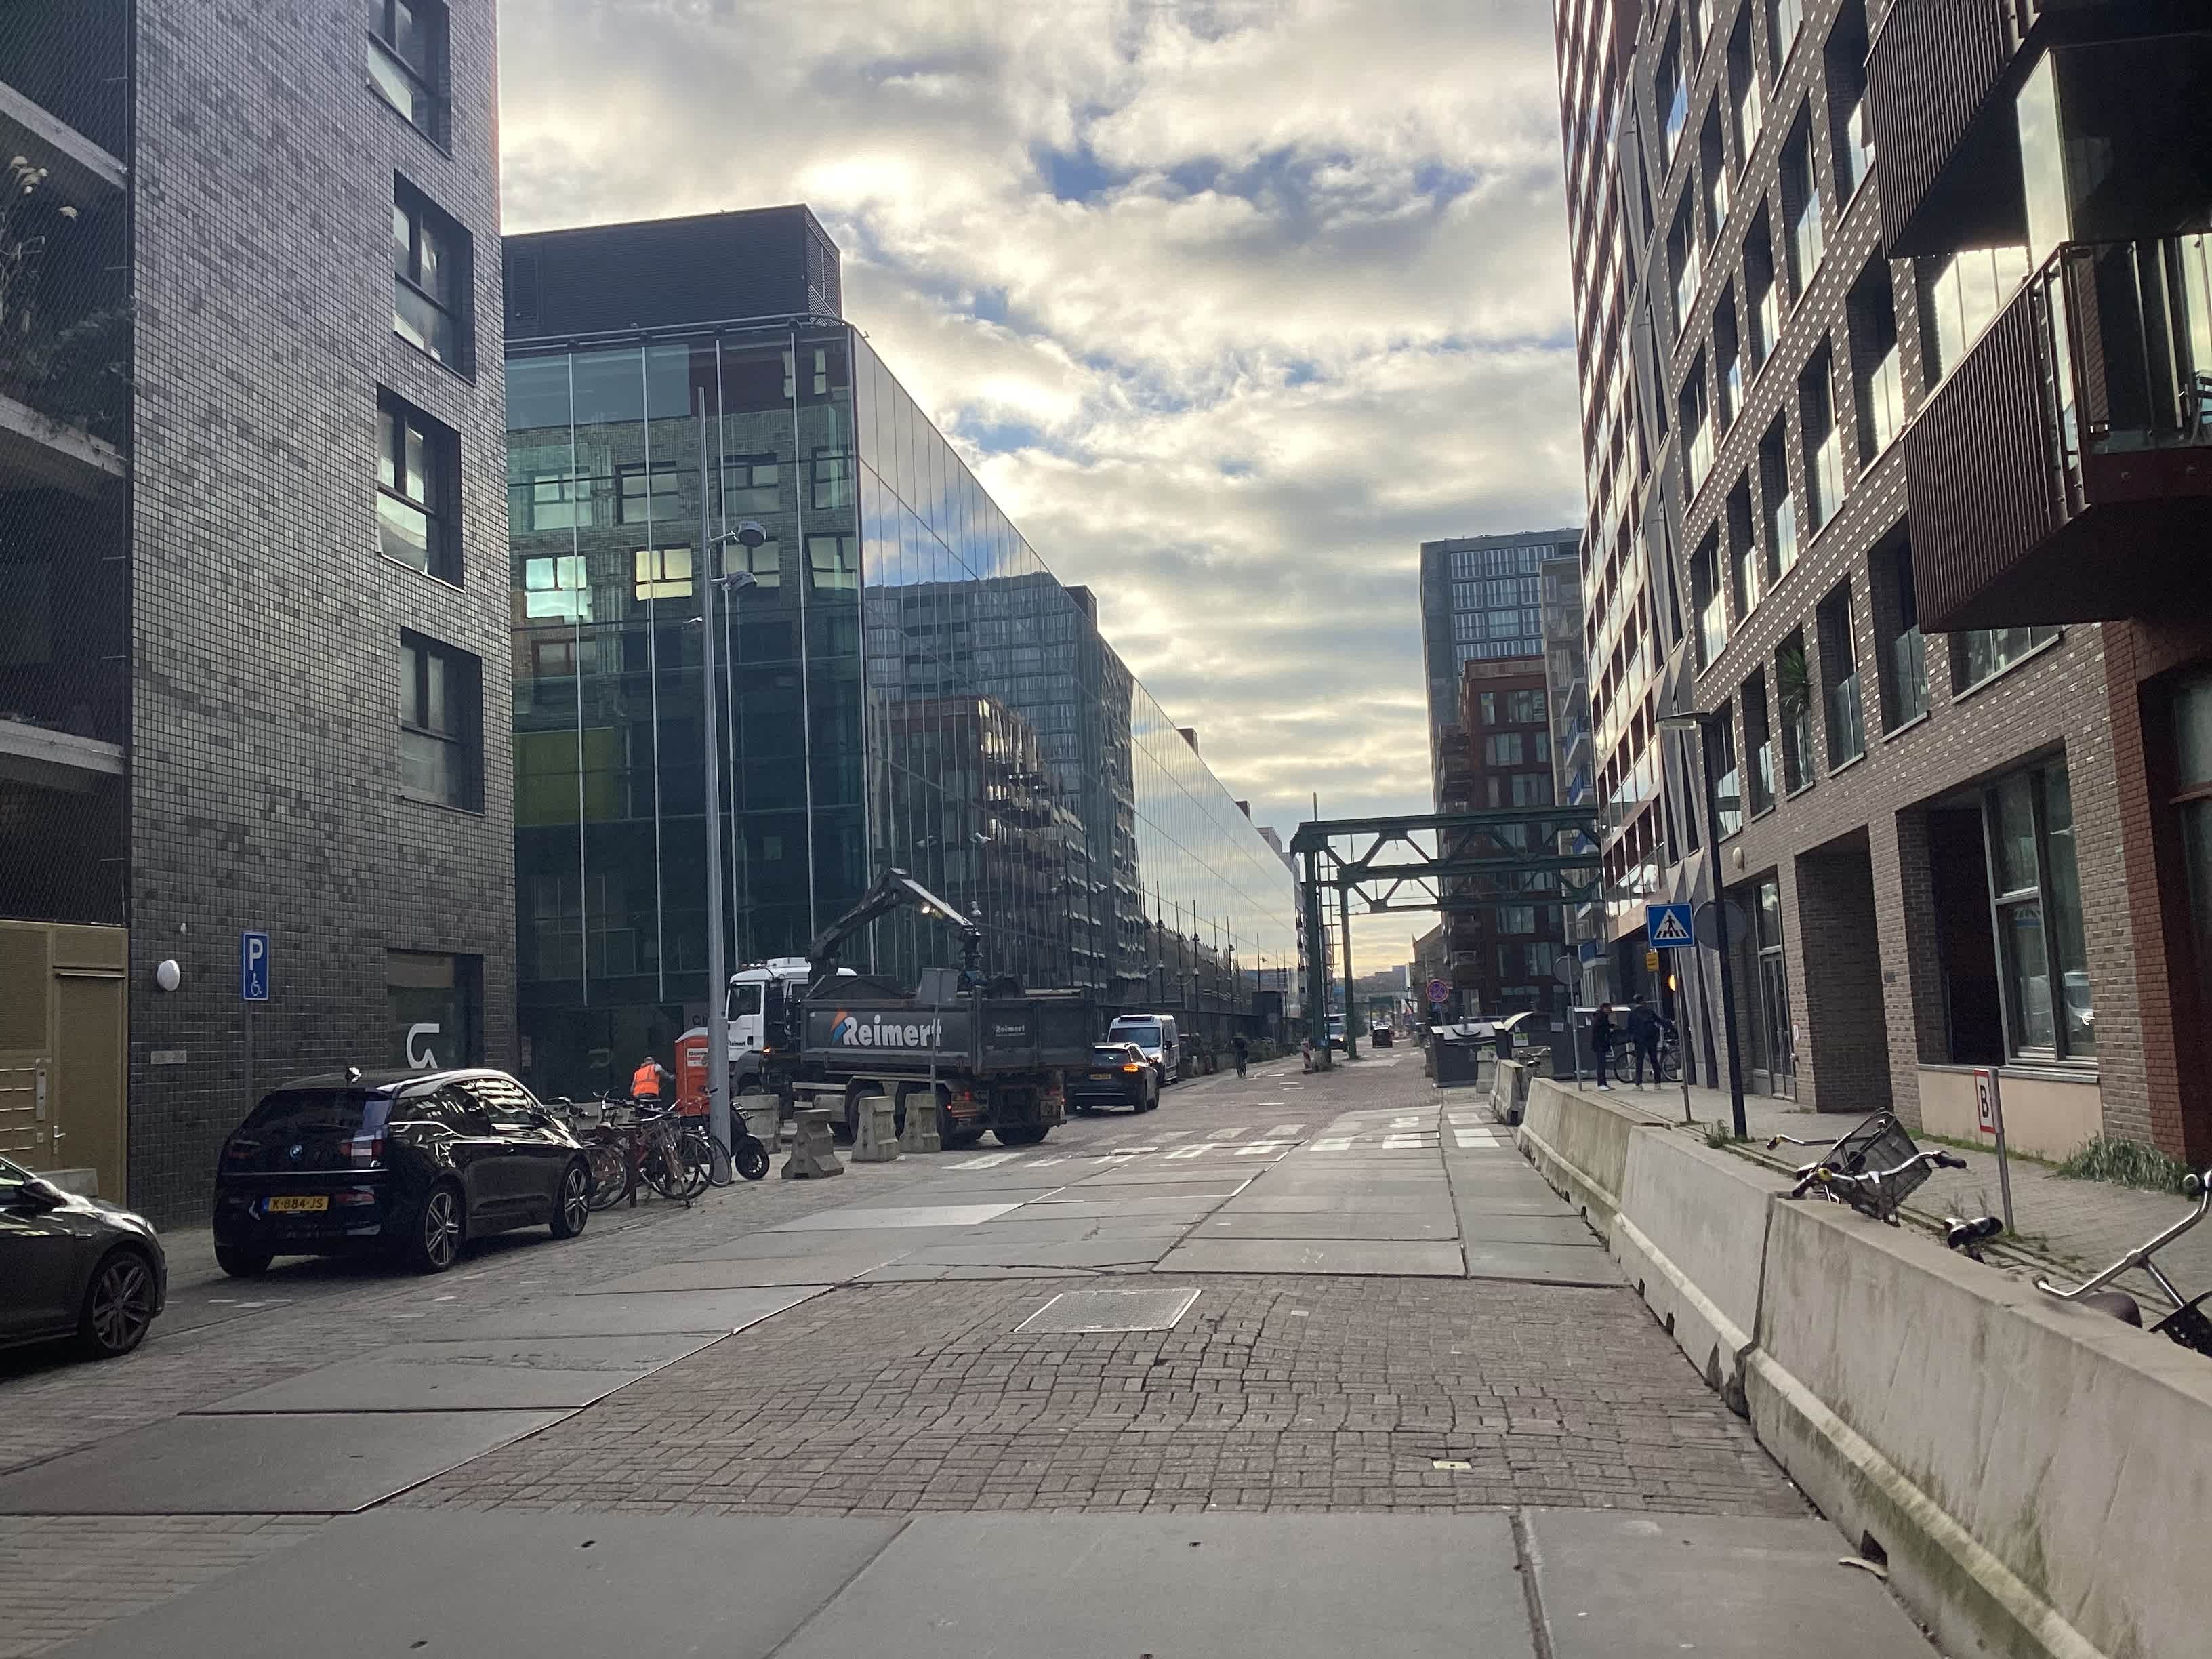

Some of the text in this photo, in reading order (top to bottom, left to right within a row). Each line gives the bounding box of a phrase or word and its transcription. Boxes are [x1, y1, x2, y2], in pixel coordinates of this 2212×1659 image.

[249, 938, 263, 971] P
[843, 1014, 942, 1047] Reimert
[1980, 1085, 1989, 1118] B
